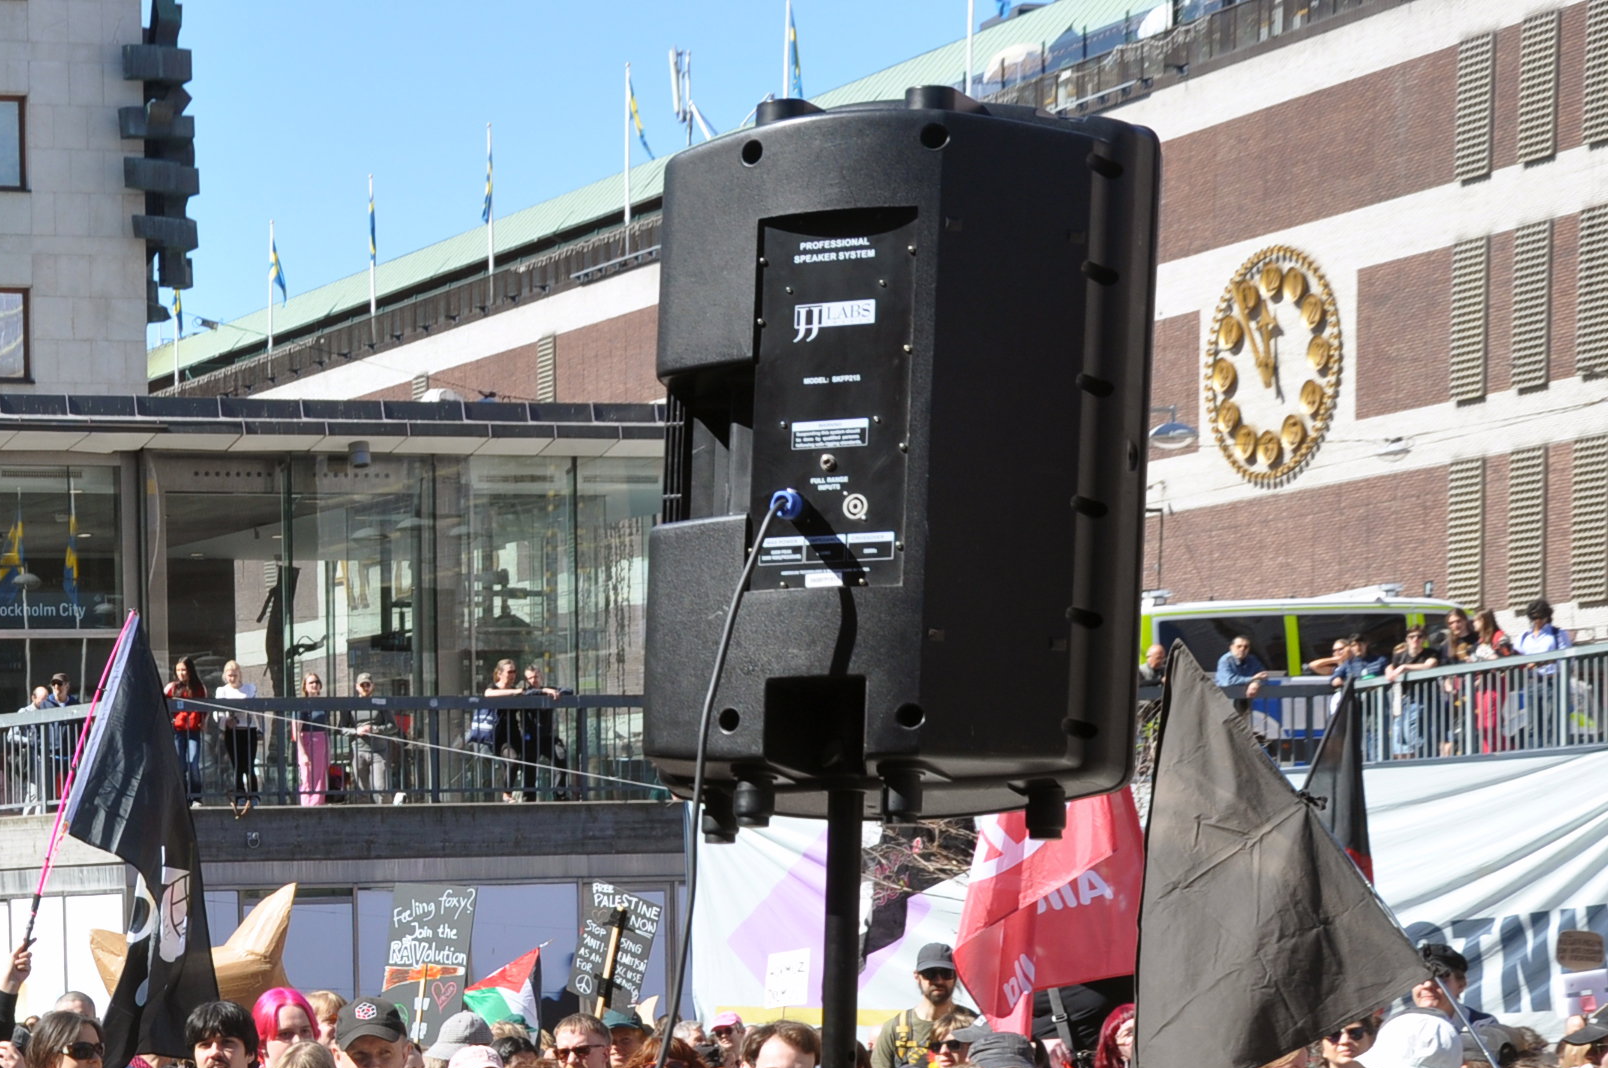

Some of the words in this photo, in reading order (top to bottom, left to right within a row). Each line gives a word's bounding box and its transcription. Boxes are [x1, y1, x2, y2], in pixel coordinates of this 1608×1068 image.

[800, 236, 870, 250] PROFESSIONAL
[794, 250, 837, 264] SPEAKER
[838, 248, 876, 260] SYSTEM
[793, 305, 823, 343] JJ
[827, 302, 871, 321] LABS
[809, 476, 826, 485] FULL
[826, 475, 849, 484] RANGE
[817, 483, 841, 491] INPUTS
[59, 602, 87, 619] City
[592, 882, 615, 893] FREE
[393, 899, 435, 928] Feeling
[438, 888, 476, 920] foxy?
[594, 894, 661, 921] PALESTINE
[410, 922, 433, 939] Join
[437, 923, 458, 939] the
[584, 919, 607, 937] STOP
[629, 914, 657, 933] NOW
[578, 946, 590, 957] AS
[589, 952, 602, 964] AN
[576, 957, 593, 974] FOR
